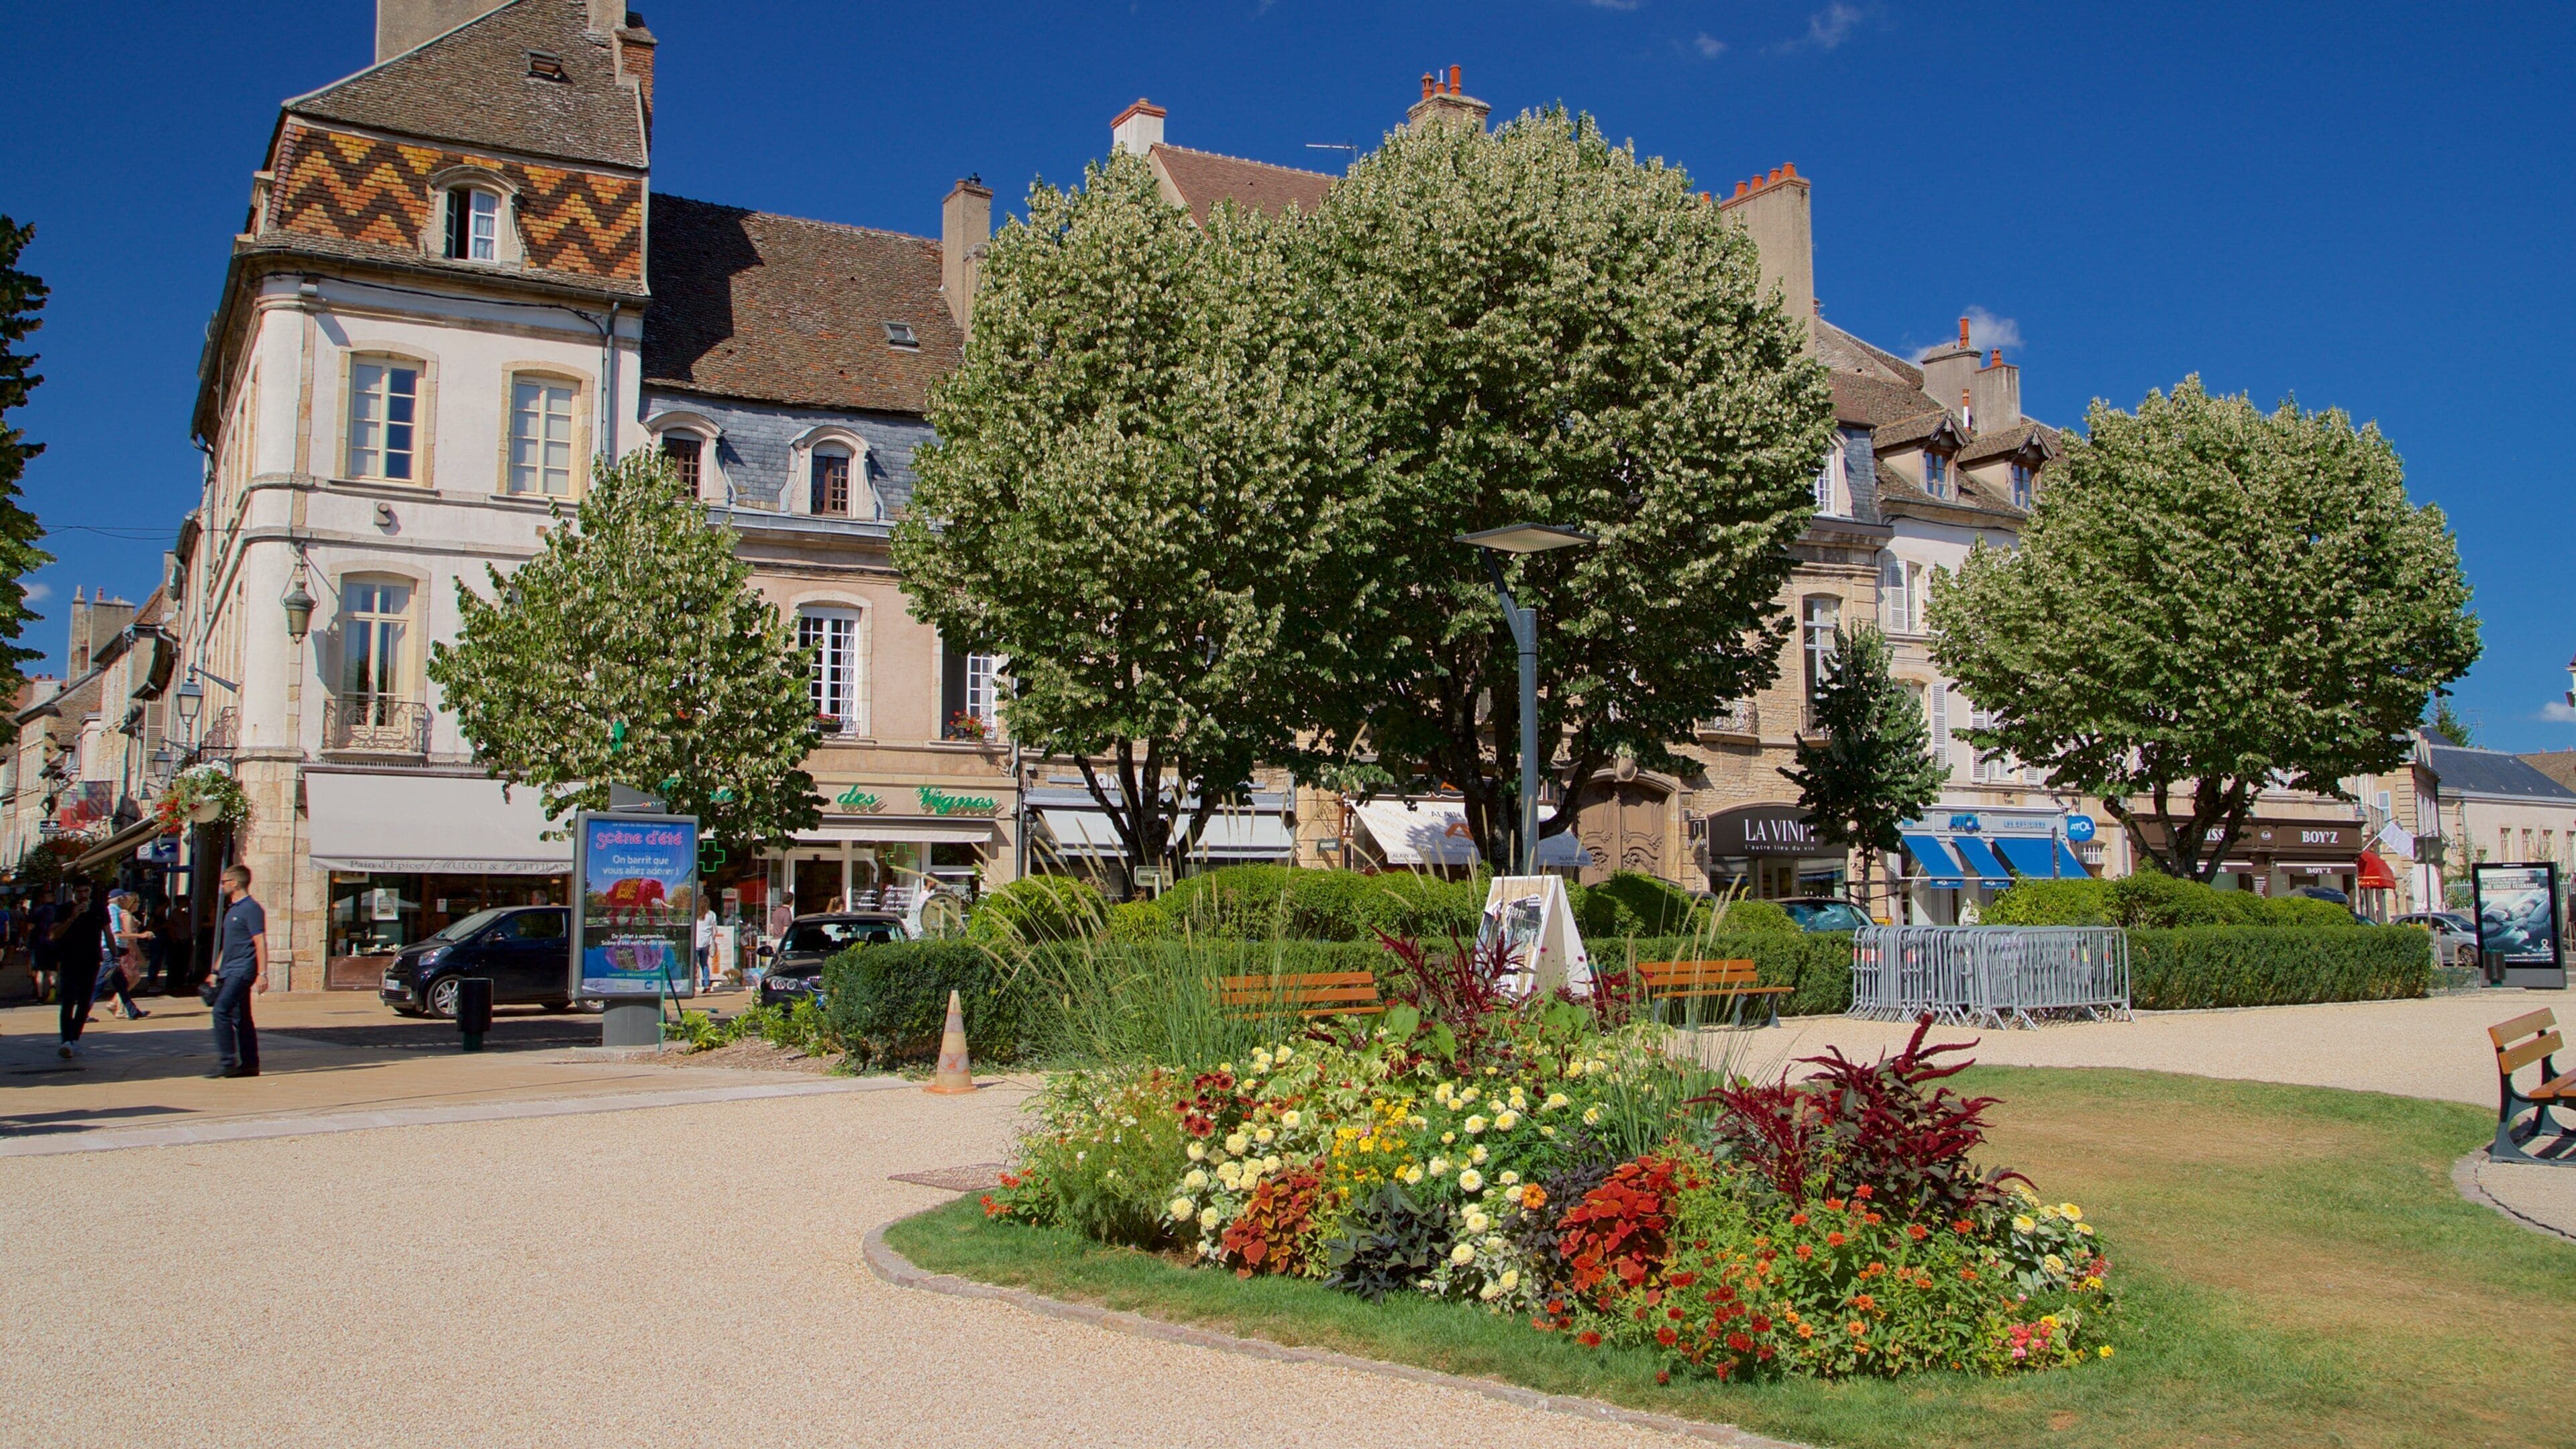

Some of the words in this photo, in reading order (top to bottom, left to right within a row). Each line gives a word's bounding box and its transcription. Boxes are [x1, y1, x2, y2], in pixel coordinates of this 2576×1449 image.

[837, 784, 877, 805] des
[915, 784, 996, 814] Vignes
[1431, 810, 1462, 818] ALAIN
[1949, 813, 1982, 833] ATOL
[2070, 820, 2092, 833] ATOL
[1744, 819, 1767, 841] LA
[2302, 830, 2339, 844] BOY'Z
[350, 860, 376, 868] Pain
[612, 855, 625, 864] On
[627, 855, 651, 865] barrit
[653, 857, 669, 867] que
[602, 867, 623, 875] vous
[625, 866, 645, 875] allez
[646, 867, 675, 875] adorer
